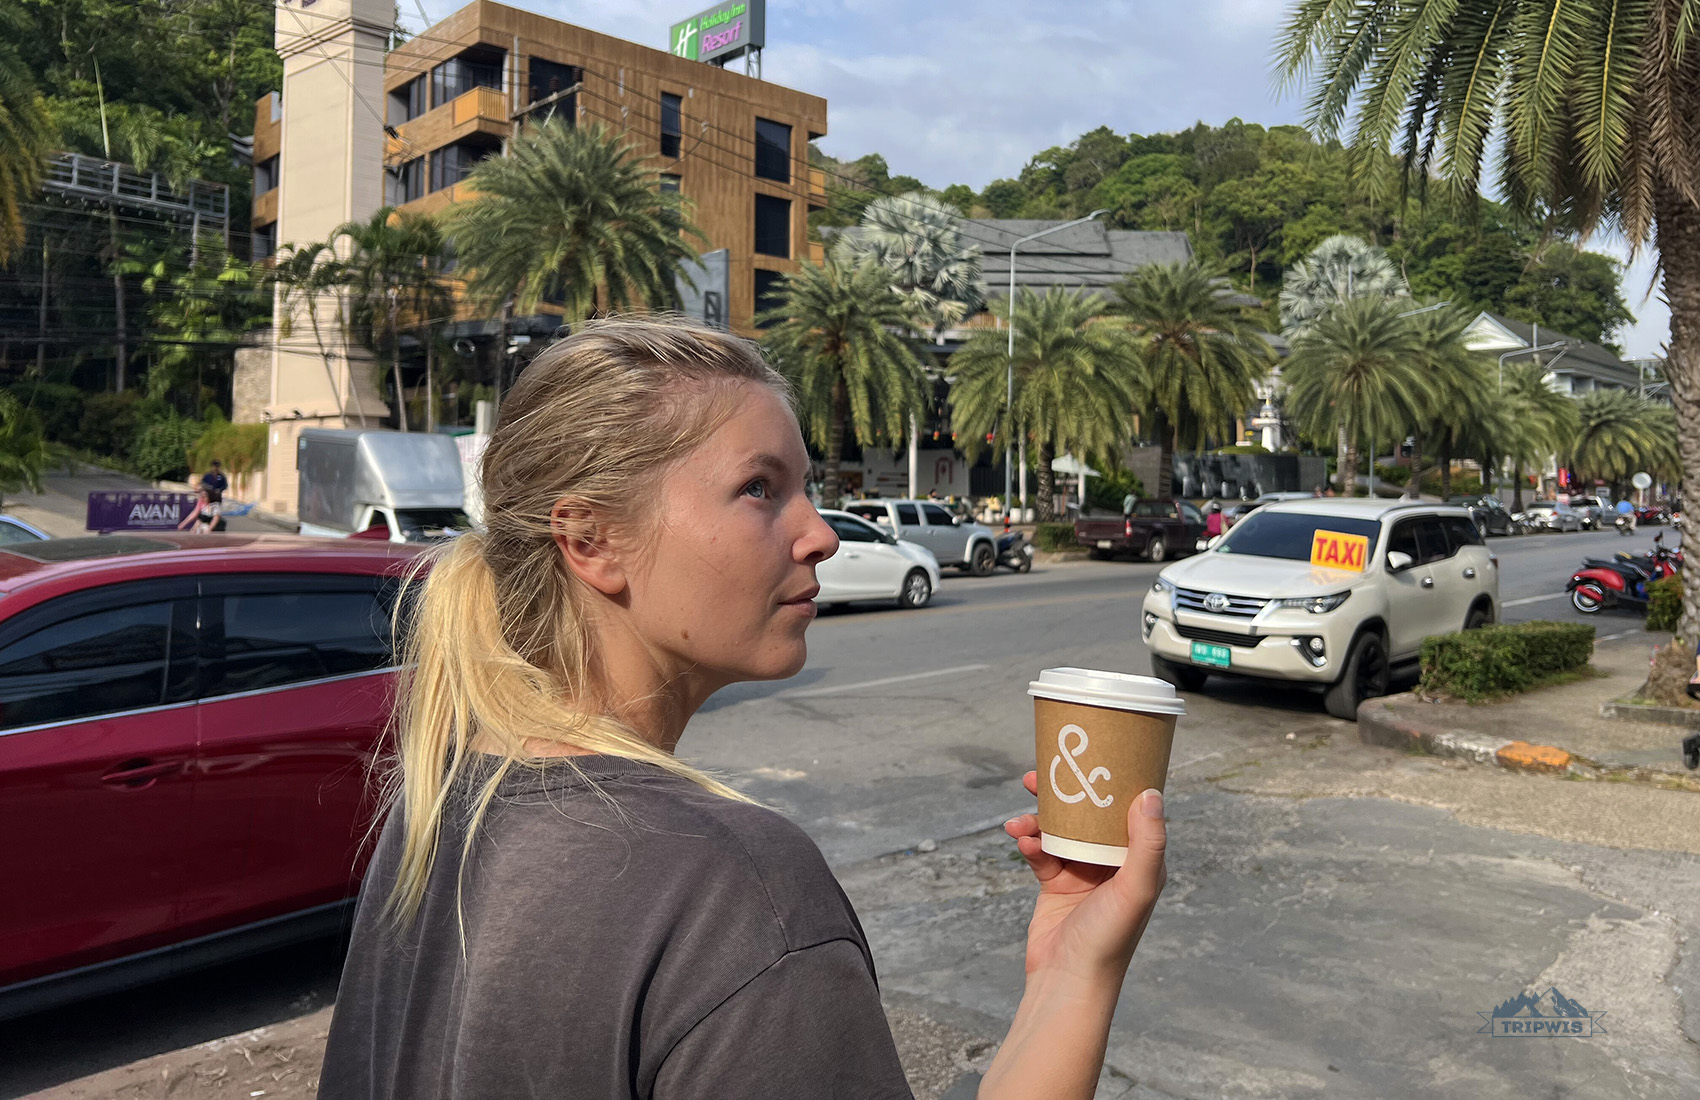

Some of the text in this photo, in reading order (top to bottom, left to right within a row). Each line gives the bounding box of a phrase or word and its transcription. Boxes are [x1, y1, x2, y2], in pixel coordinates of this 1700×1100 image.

[700, 3, 746, 31] Holiday Inn
[702, 21, 742, 54] Resort
[1316, 537, 1363, 567] TAXI
